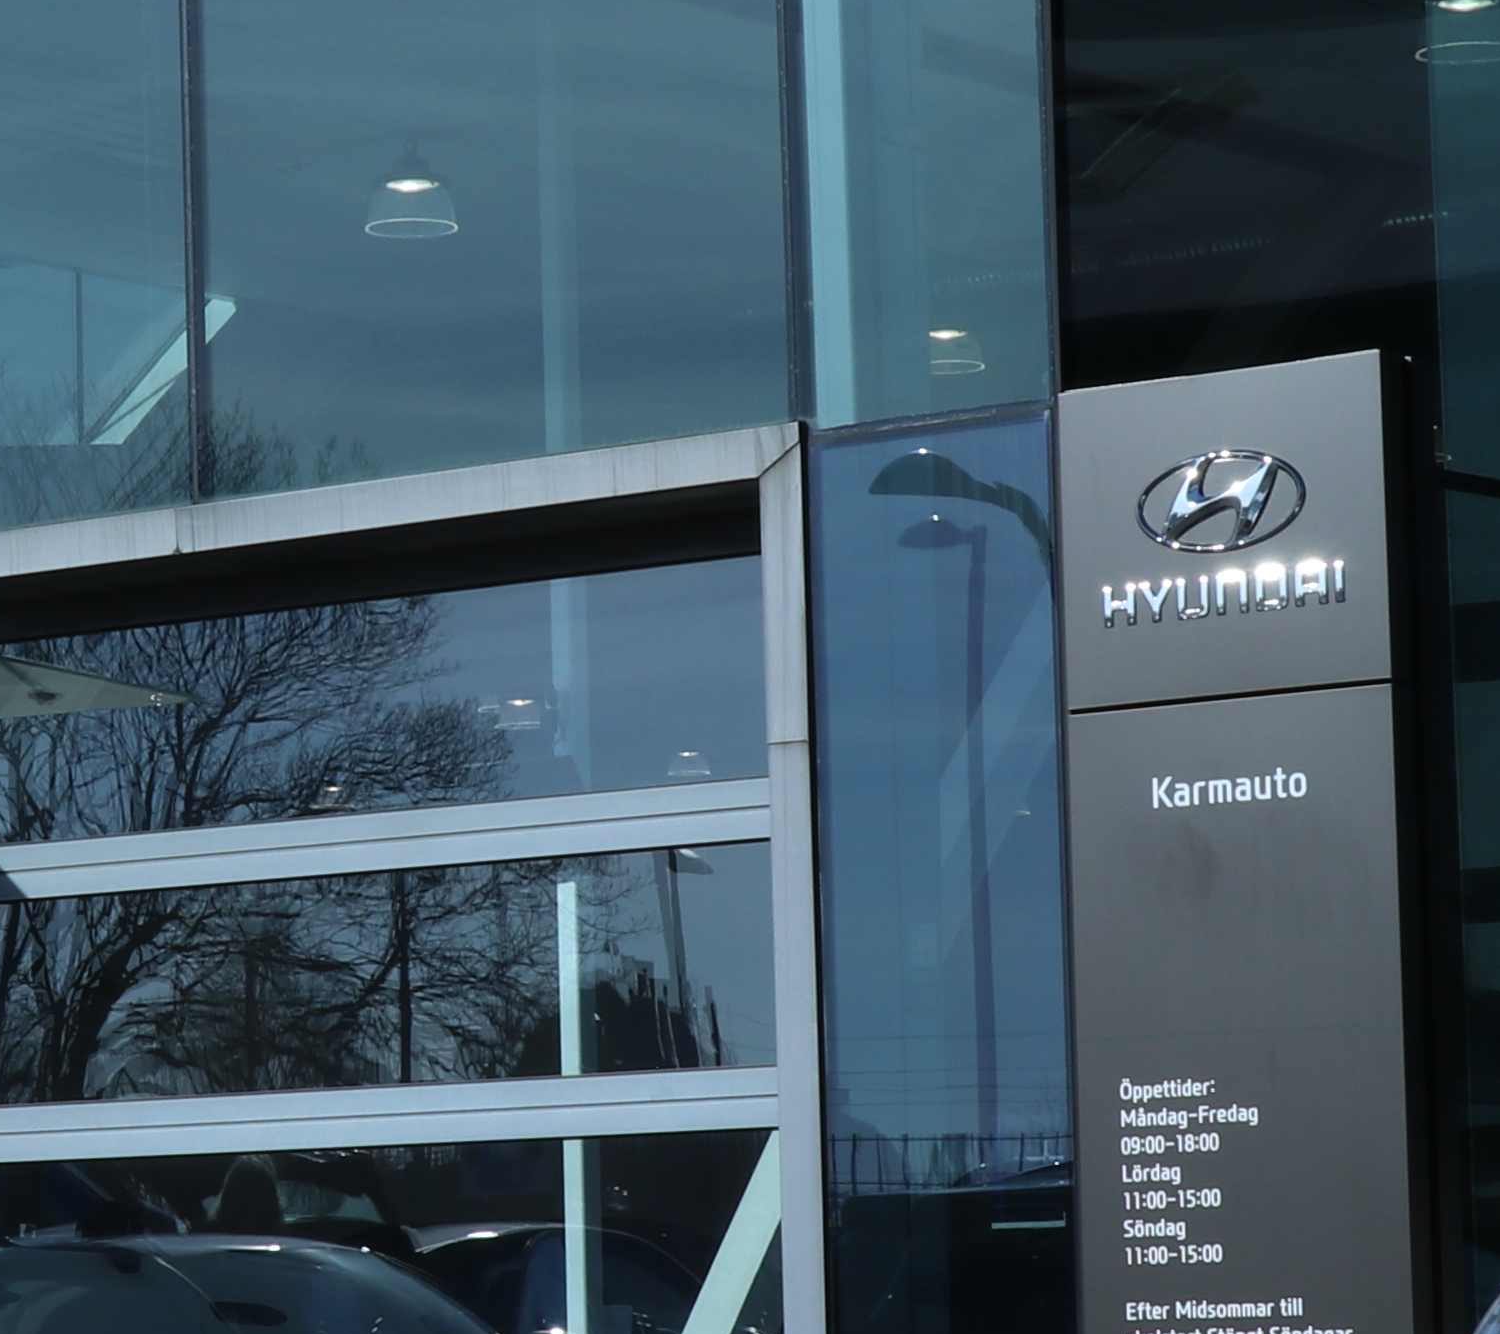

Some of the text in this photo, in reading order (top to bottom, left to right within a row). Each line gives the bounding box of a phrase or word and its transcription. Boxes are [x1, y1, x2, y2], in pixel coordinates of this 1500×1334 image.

[1102, 558, 1346, 628] HYUNDAI
[1151, 766, 1308, 810] Karmauto
[1119, 1077, 1216, 1104] Öppettider:
[1120, 1103, 1259, 1129] Måndag-Fredag
[1121, 1132, 1220, 1155] 09:00-18:00
[1121, 1163, 1182, 1185] Lördag
[1123, 1188, 1222, 1210] 11:00-15:00
[1123, 1218, 1187, 1240] Söndag
[1125, 1243, 1223, 1265] 11:00-15:00
[1125, 1297, 1303, 1321] Efter Midsommar till
